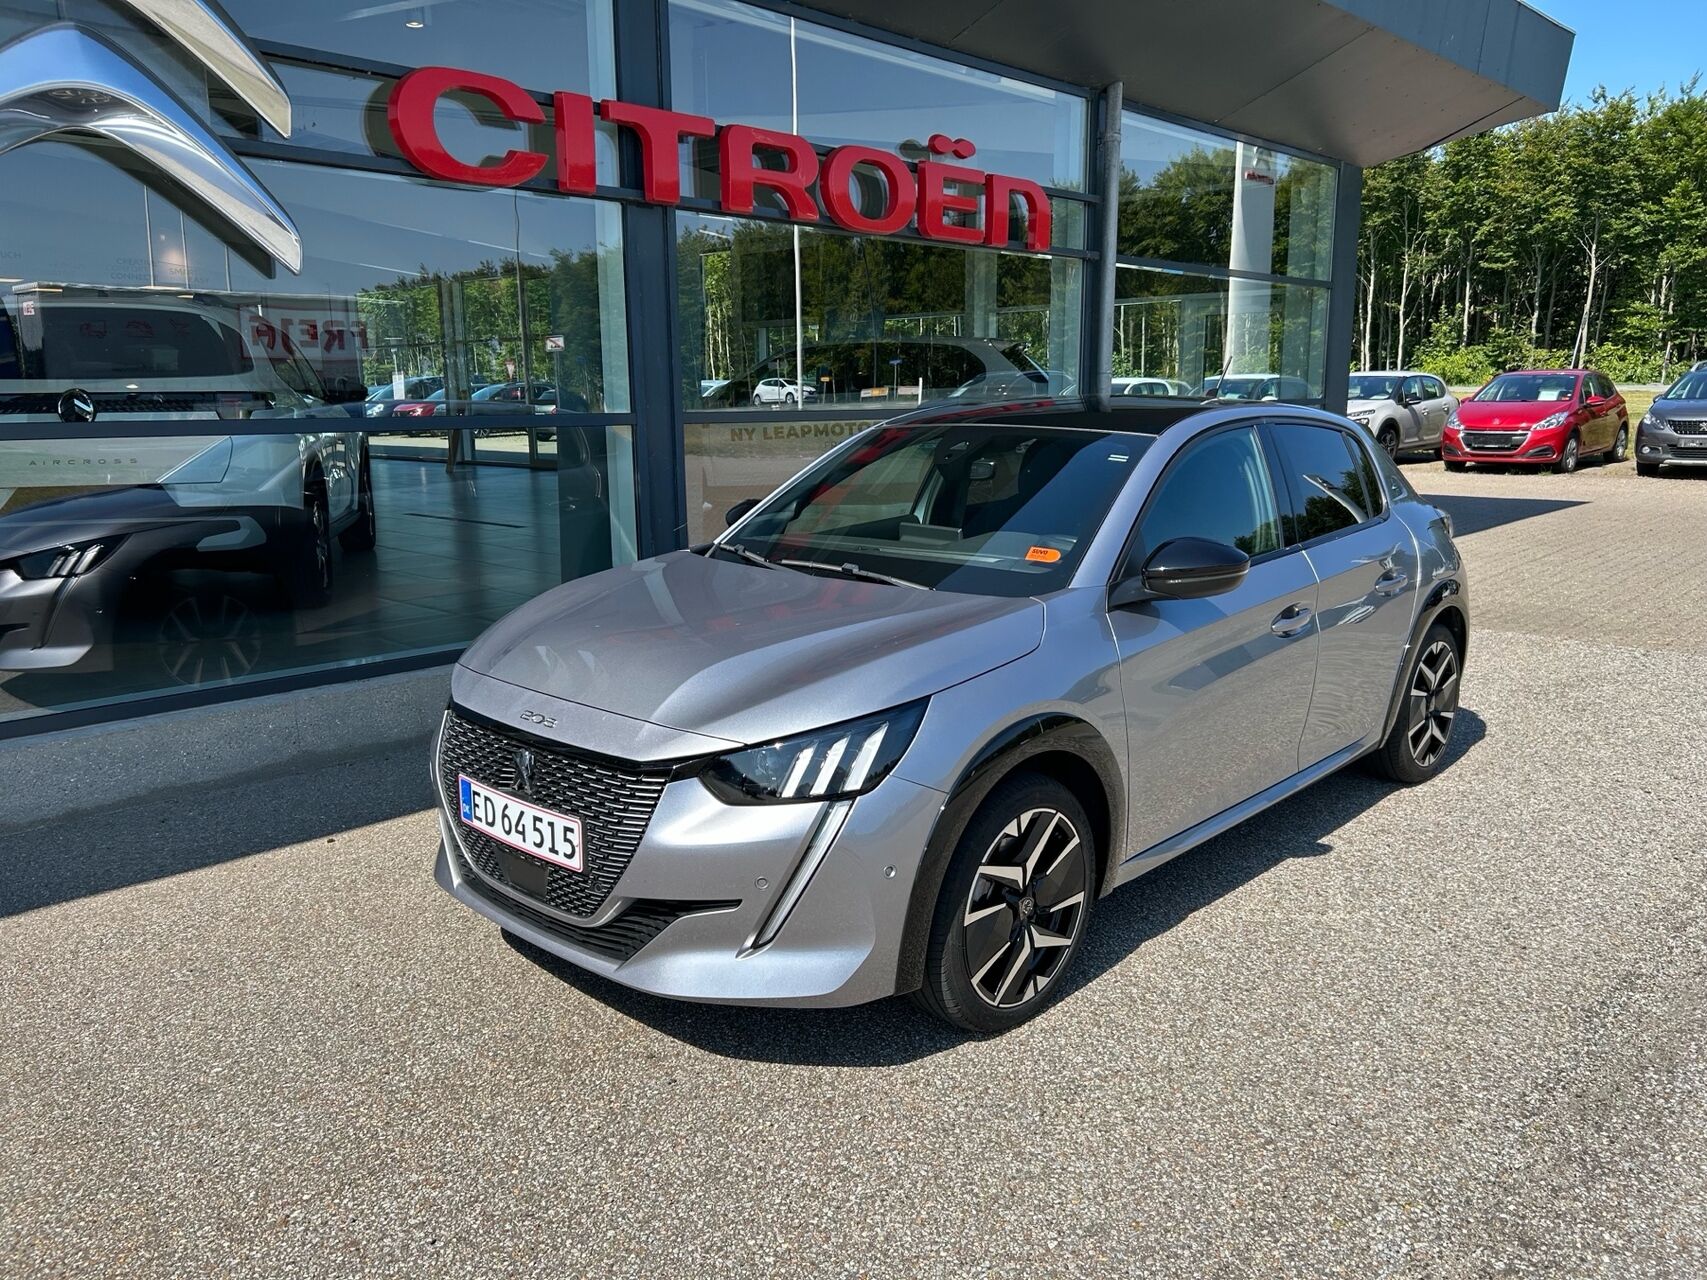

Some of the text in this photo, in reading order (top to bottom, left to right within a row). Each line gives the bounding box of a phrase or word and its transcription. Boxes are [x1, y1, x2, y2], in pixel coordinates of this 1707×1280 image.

[387, 66, 1051, 252] CITROËN
[730, 421, 880, 442] NY LEAPMOTO
[29, 458, 138, 466] AIRCROSS
[472, 790, 577, 860] ED 64 515
